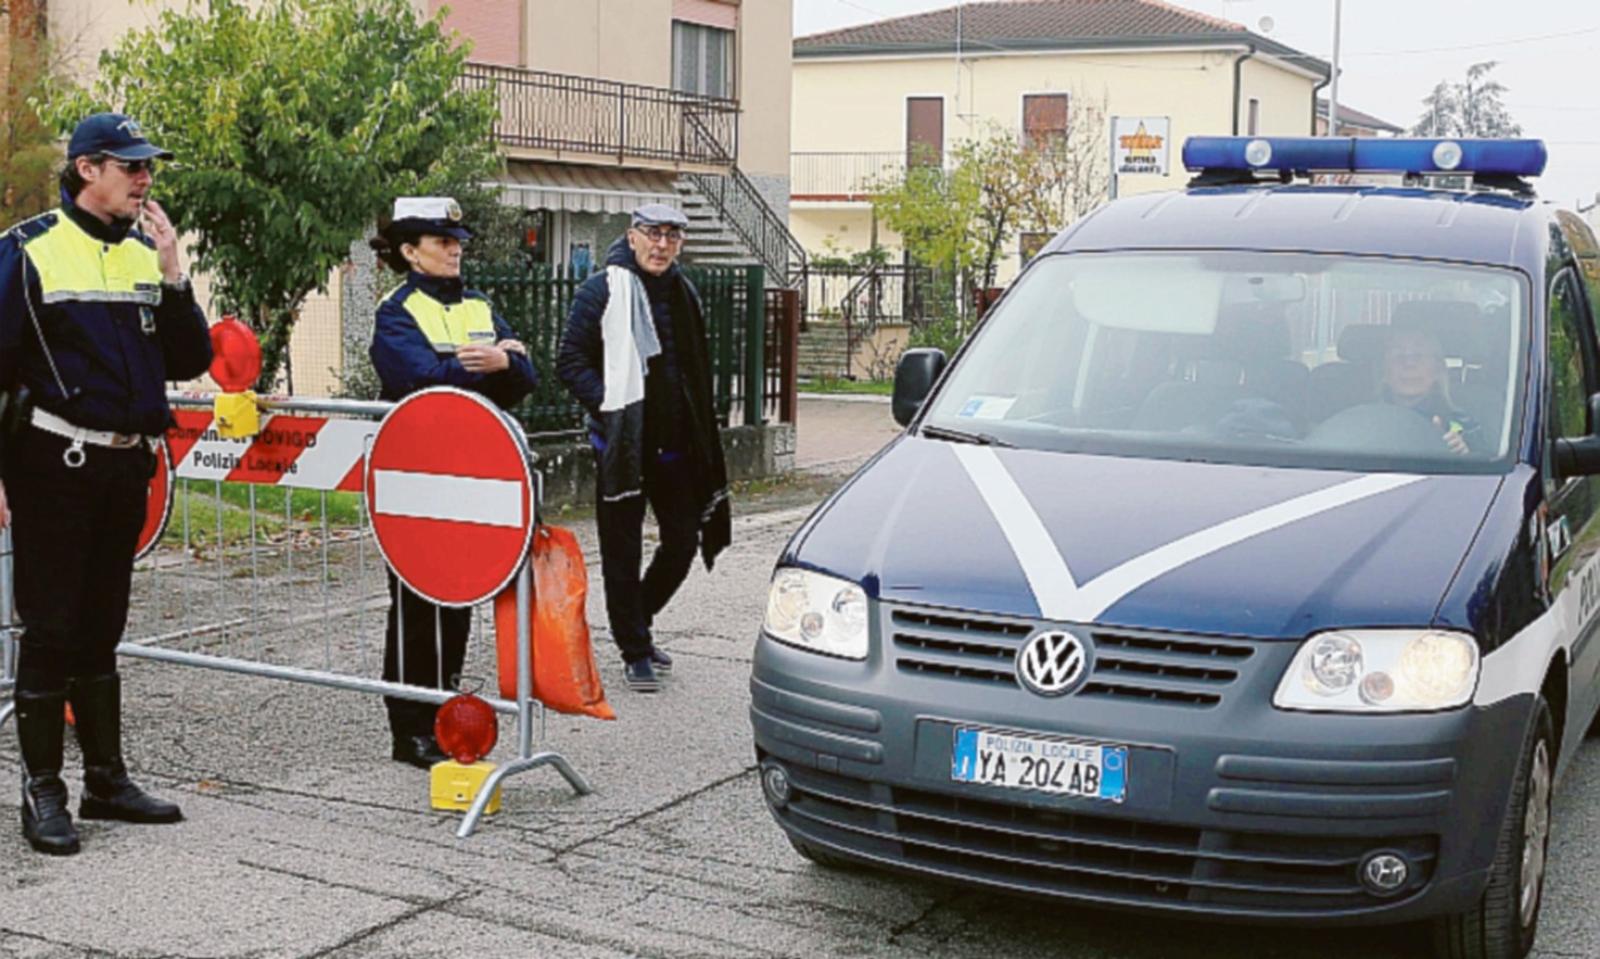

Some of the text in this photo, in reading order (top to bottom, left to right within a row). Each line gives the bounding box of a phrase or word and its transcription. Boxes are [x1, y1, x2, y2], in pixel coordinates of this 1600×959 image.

[167, 426, 228, 442] Comun
[193, 450, 241, 469] Polizia
[1021, 630, 1085, 691] VW
[986, 736, 1094, 761] POLIZIA LOCALE
[980, 750, 1099, 793] YA 204 AB
